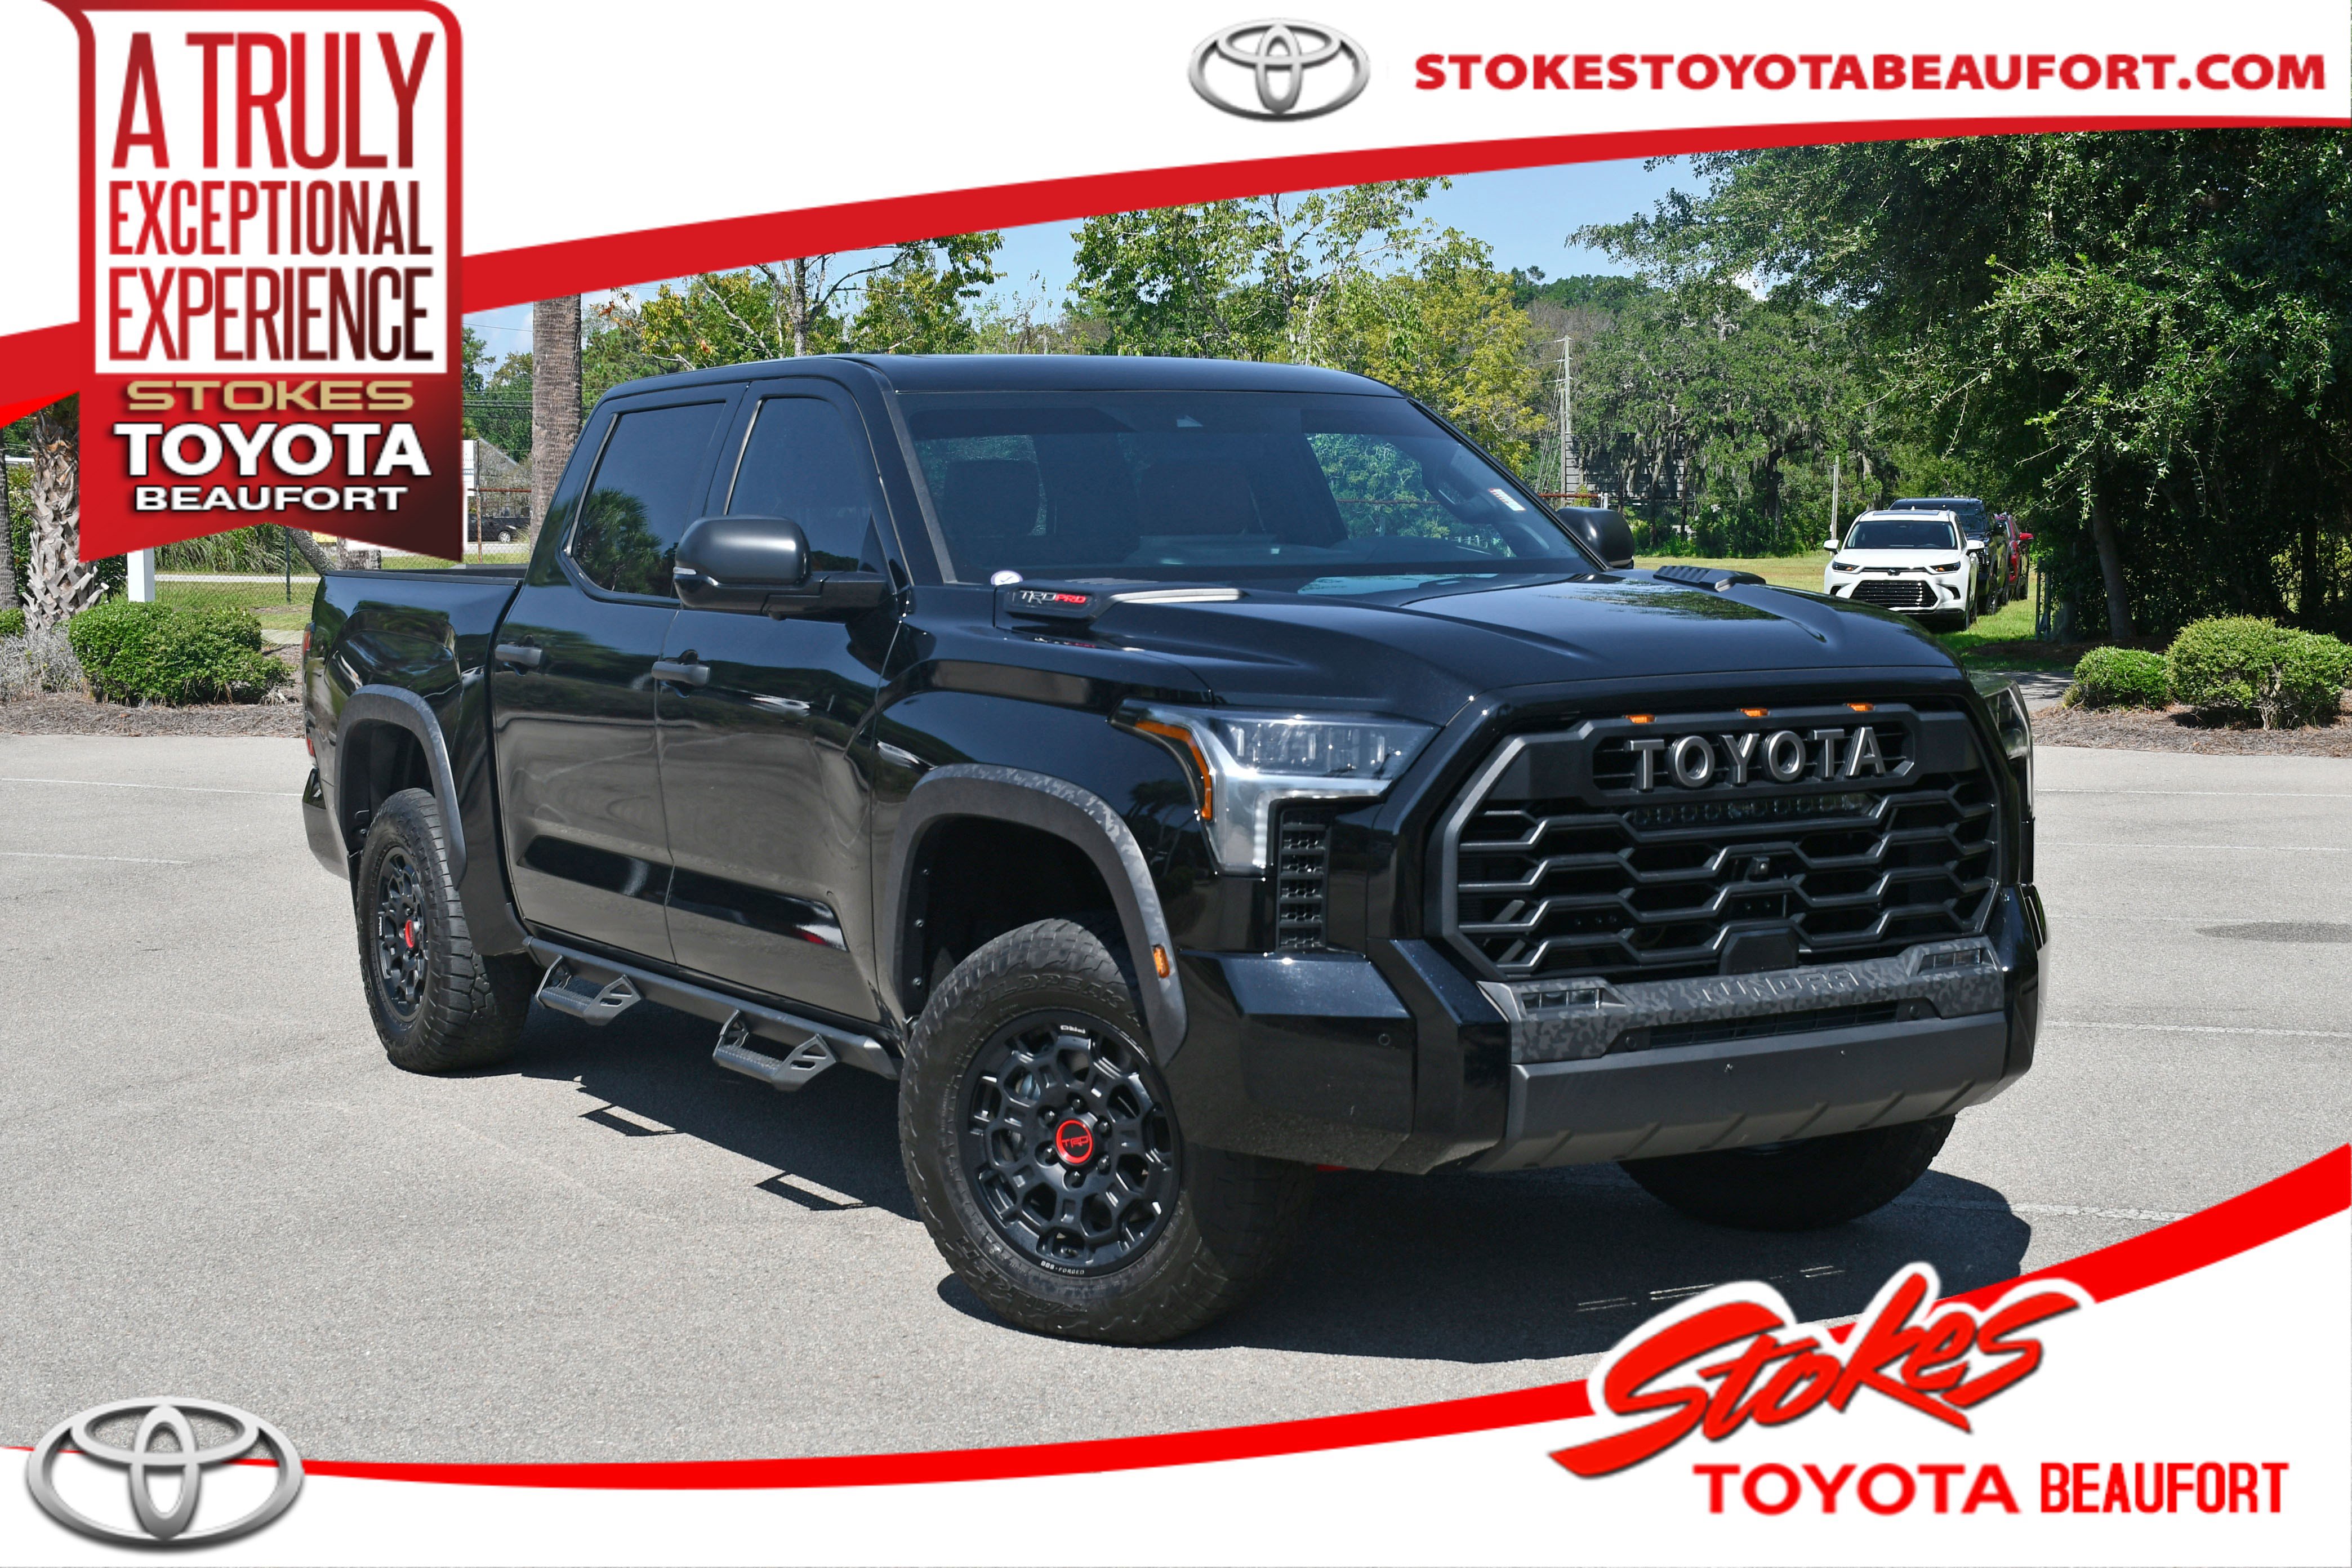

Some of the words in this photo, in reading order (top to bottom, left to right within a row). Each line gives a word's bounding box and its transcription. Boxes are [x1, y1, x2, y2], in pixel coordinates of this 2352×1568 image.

[1625, 726, 1887, 791] TOYOTA
[1693, 968, 1860, 1002] TUNDRA
[1062, 1135, 1089, 1148] TRD
[1058, 1267, 1085, 1275] FORGED
